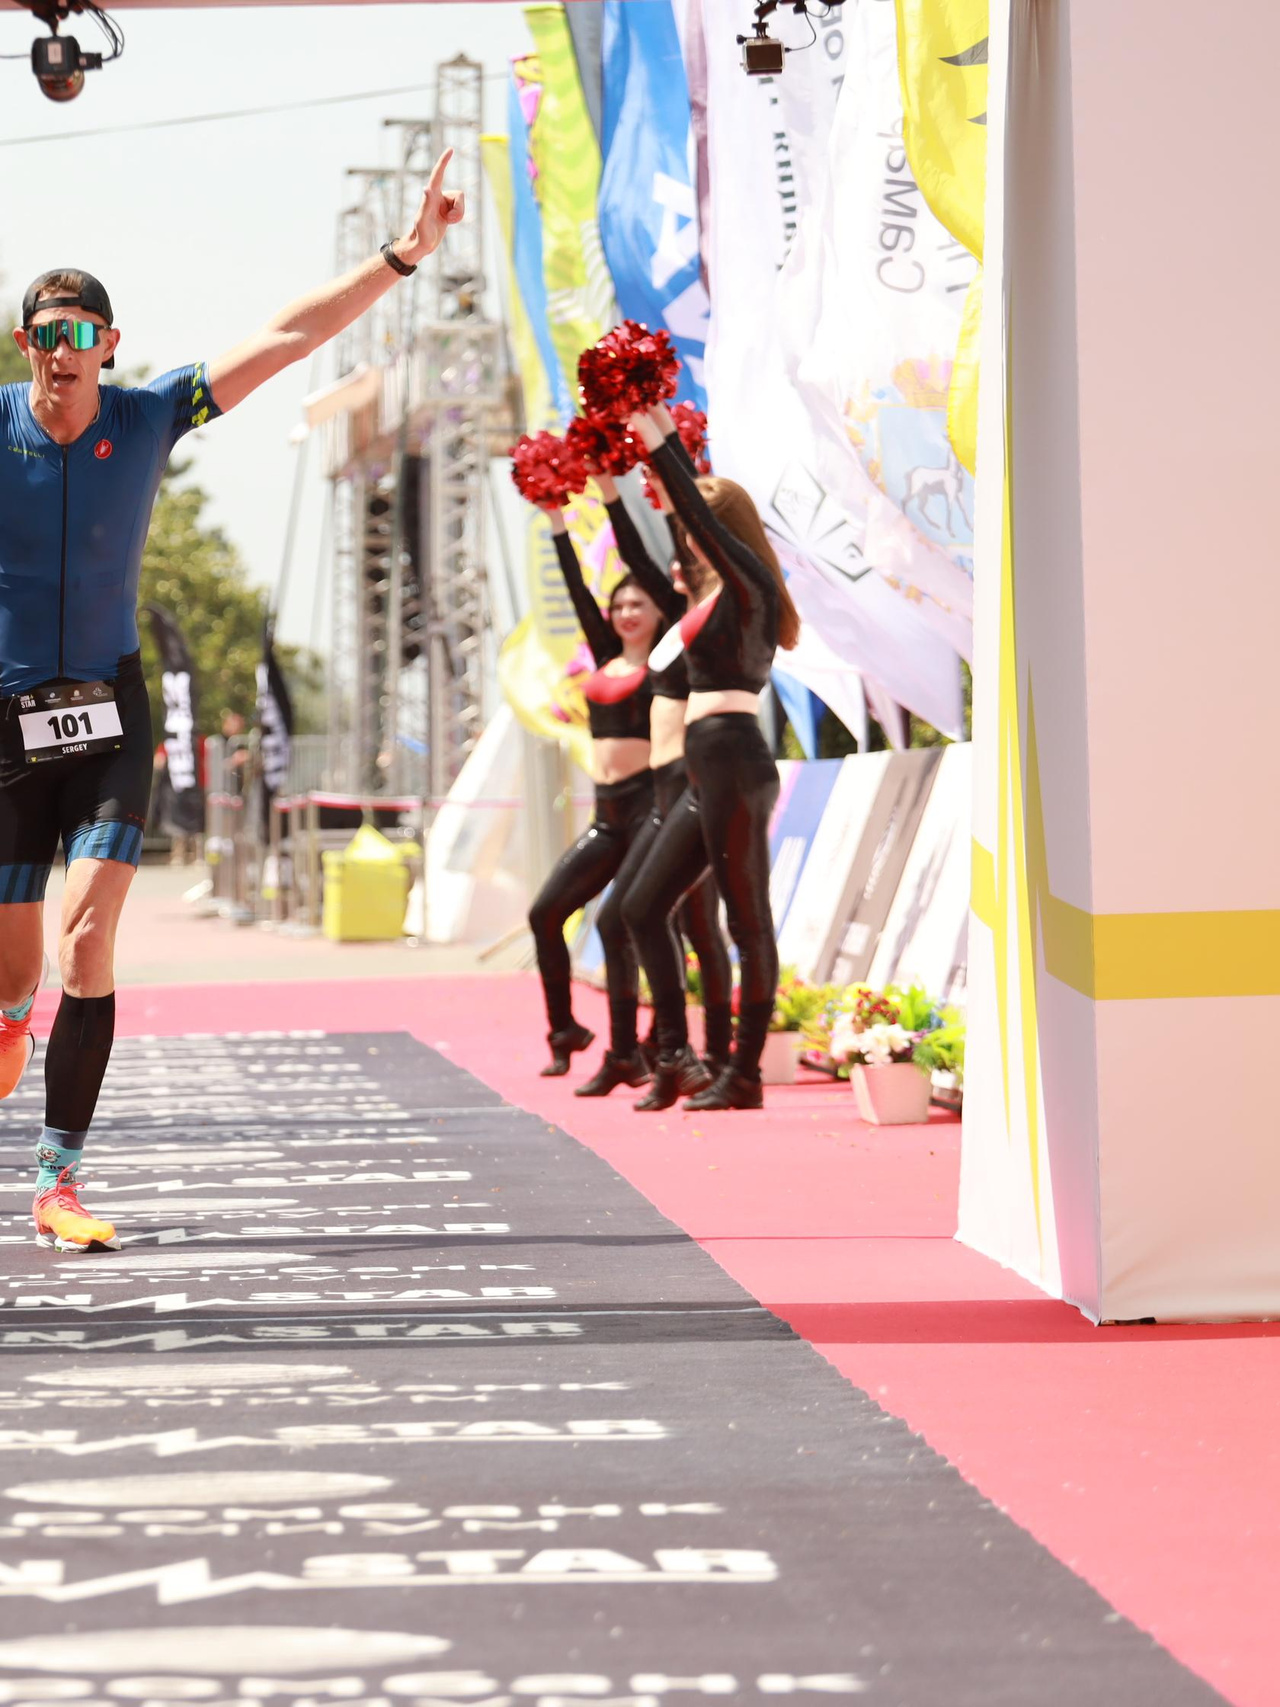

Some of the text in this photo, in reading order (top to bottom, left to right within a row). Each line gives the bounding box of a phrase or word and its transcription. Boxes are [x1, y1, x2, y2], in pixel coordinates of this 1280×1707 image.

[21, 699, 36, 709] STAR
[47, 711, 93, 740] 101
[62, 743, 88, 754] SERGEY
[249, 1286, 557, 1300] STAR
[252, 1322, 583, 1337] STAR
[274, 1420, 666, 1438] STAR
[303, 1549, 778, 1577] STAR
